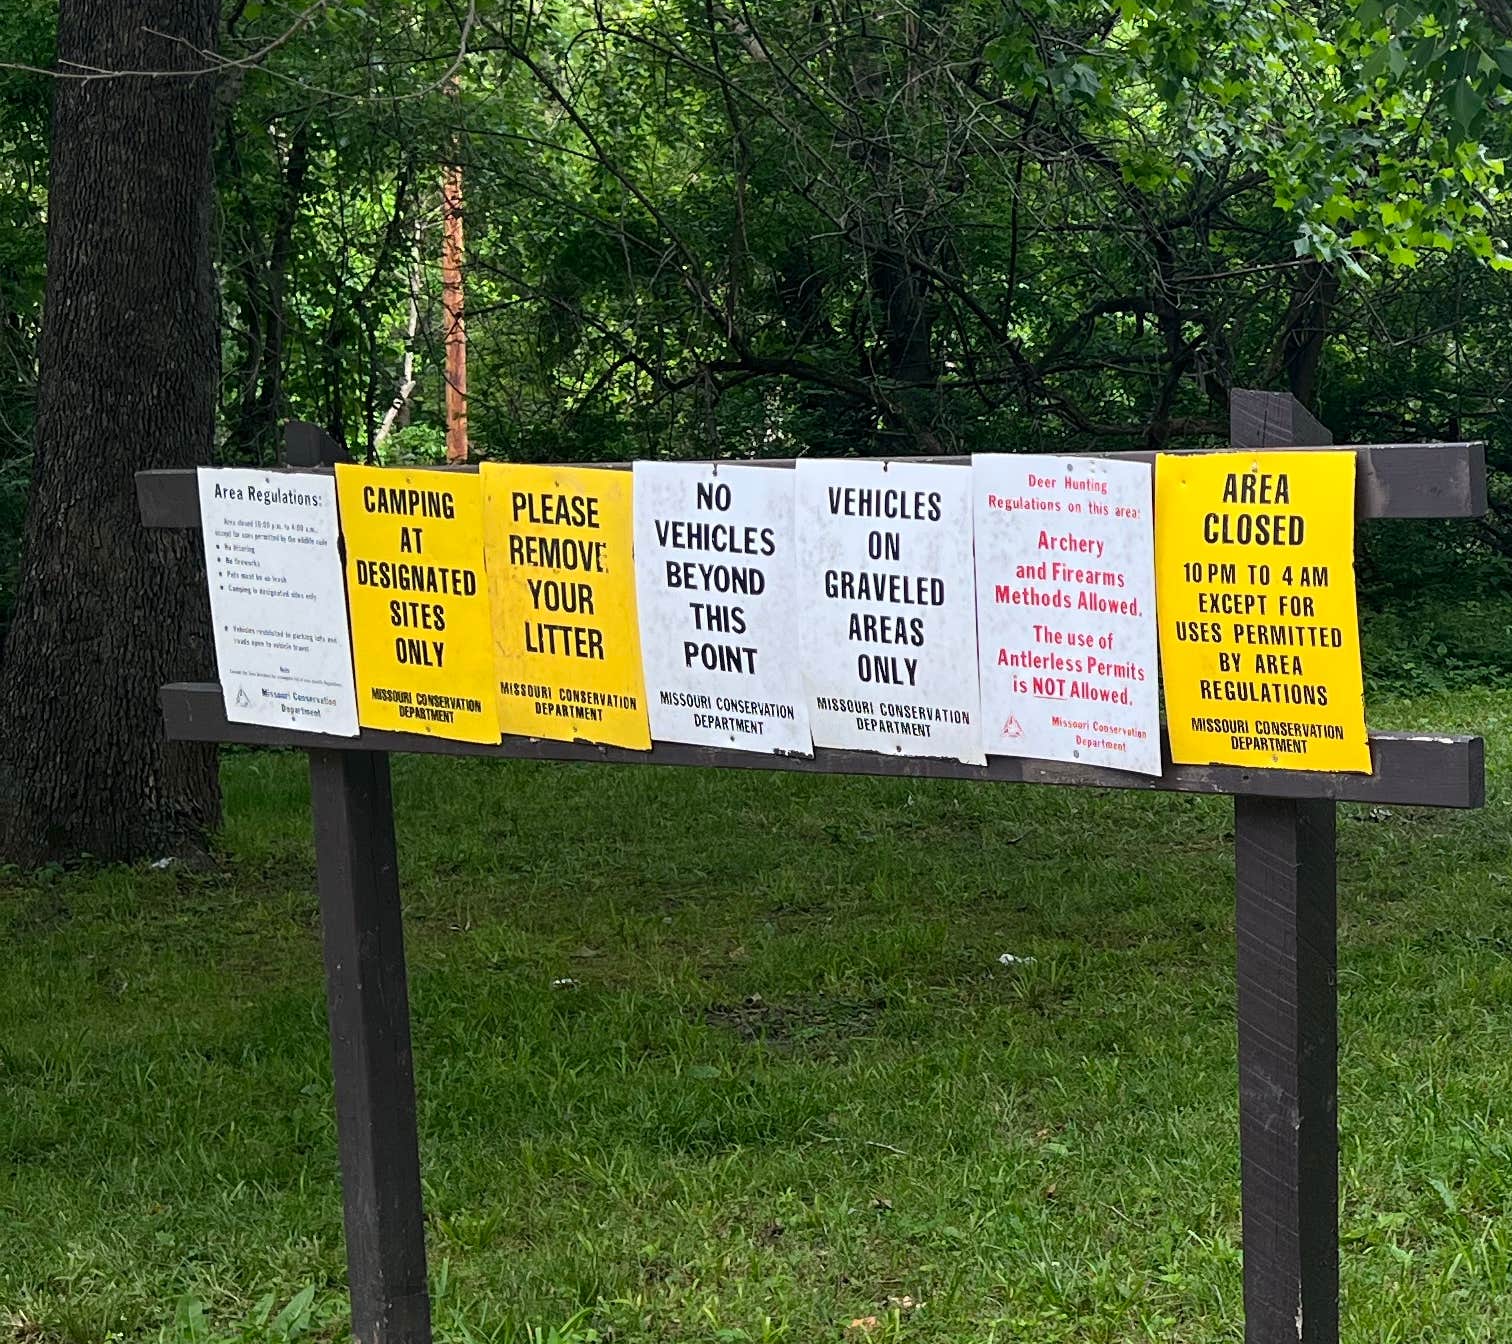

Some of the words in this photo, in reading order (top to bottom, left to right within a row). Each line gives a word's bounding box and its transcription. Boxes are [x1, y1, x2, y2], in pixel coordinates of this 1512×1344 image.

[214, 483, 243, 500] Area
[248, 486, 322, 507] Regulations:
[697, 482, 731, 512] NO
[1028, 474, 1057, 488] Deer
[1065, 476, 1108, 495] Hunting
[1223, 473, 1290, 504] AREA
[363, 486, 455, 519] CAMPING
[512, 491, 600, 529] PLEASE
[828, 486, 942, 522] VEHICLES
[988, 495, 1061, 512] Regulations
[1068, 503, 1082, 513] on
[1089, 501, 1109, 516] this
[1115, 506, 1141, 518] area:
[400, 526, 423, 554] AT
[654, 519, 776, 557] VEHICLES
[1204, 513, 1304, 546] CLOSED
[868, 531, 899, 561] ON
[1038, 530, 1104, 558] Archery
[357, 559, 476, 596] DESIGNATED
[666, 560, 765, 596] BEYOND
[825, 570, 944, 607] GRAVELED
[1016, 562, 1047, 580] and
[1052, 562, 1125, 588] Firearms
[1184, 562, 1202, 583] 10
[1208, 563, 1236, 584] PM
[1248, 564, 1270, 586] TO
[1282, 566, 1293, 586] 4
[1300, 566, 1328, 587] AM
[527, 579, 594, 615] YOUR
[995, 585, 1072, 608] Methods
[1078, 591, 1142, 617] Allowed.
[1199, 593, 1267, 615] EXCEPT
[1279, 596, 1314, 617] FOR
[389, 600, 445, 632] SITES
[689, 602, 746, 635] THIS
[525, 621, 604, 660] LITTER
[849, 614, 924, 647] AREAS
[1033, 625, 1063, 644] The
[1068, 632, 1094, 647] use
[1099, 633, 1113, 650] of
[1176, 621, 1222, 643] USES
[1234, 624, 1342, 648] PERMITTED
[396, 637, 444, 668] ONLY
[684, 641, 758, 675] POINT
[998, 648, 1083, 672] Antlerless
[1087, 656, 1145, 681] Permits
[1219, 652, 1240, 672] BY
[1256, 654, 1303, 676] AREA
[858, 654, 918, 687] ONLY
[262, 688, 290, 699] Missouri
[293, 692, 336, 706] Conservation
[371, 687, 412, 704] MISSOURI
[416, 692, 482, 713] CONSERVATION
[500, 682, 552, 699] MISSOURI
[559, 688, 637, 711] CONSERVATION
[1013, 675, 1028, 693] is
[1033, 677, 1066, 697] NOT
[1070, 681, 1133, 706] Allowed.
[1200, 680, 1328, 706] REGULATIONS
[281, 704, 321, 718] Department
[400, 705, 454, 723] DEPARTMENT
[535, 702, 603, 722] DEPARTMENT
[660, 690, 712, 709] MISSOURI
[716, 697, 794, 720] CONSERVATION
[817, 697, 874, 715] MISSOURI
[879, 703, 970, 725] CONSERVATION
[694, 714, 764, 735] DEPARTMENT
[856, 717, 931, 738] DEPARTMENT
[1052, 717, 1090, 731] Missouri
[1093, 721, 1147, 739] Conservation
[1192, 718, 1249, 733] MISSOURI
[1256, 721, 1344, 740] CONSERVATION
[1076, 735, 1127, 752] Department
[1231, 736, 1307, 754] DEPARTMENT
